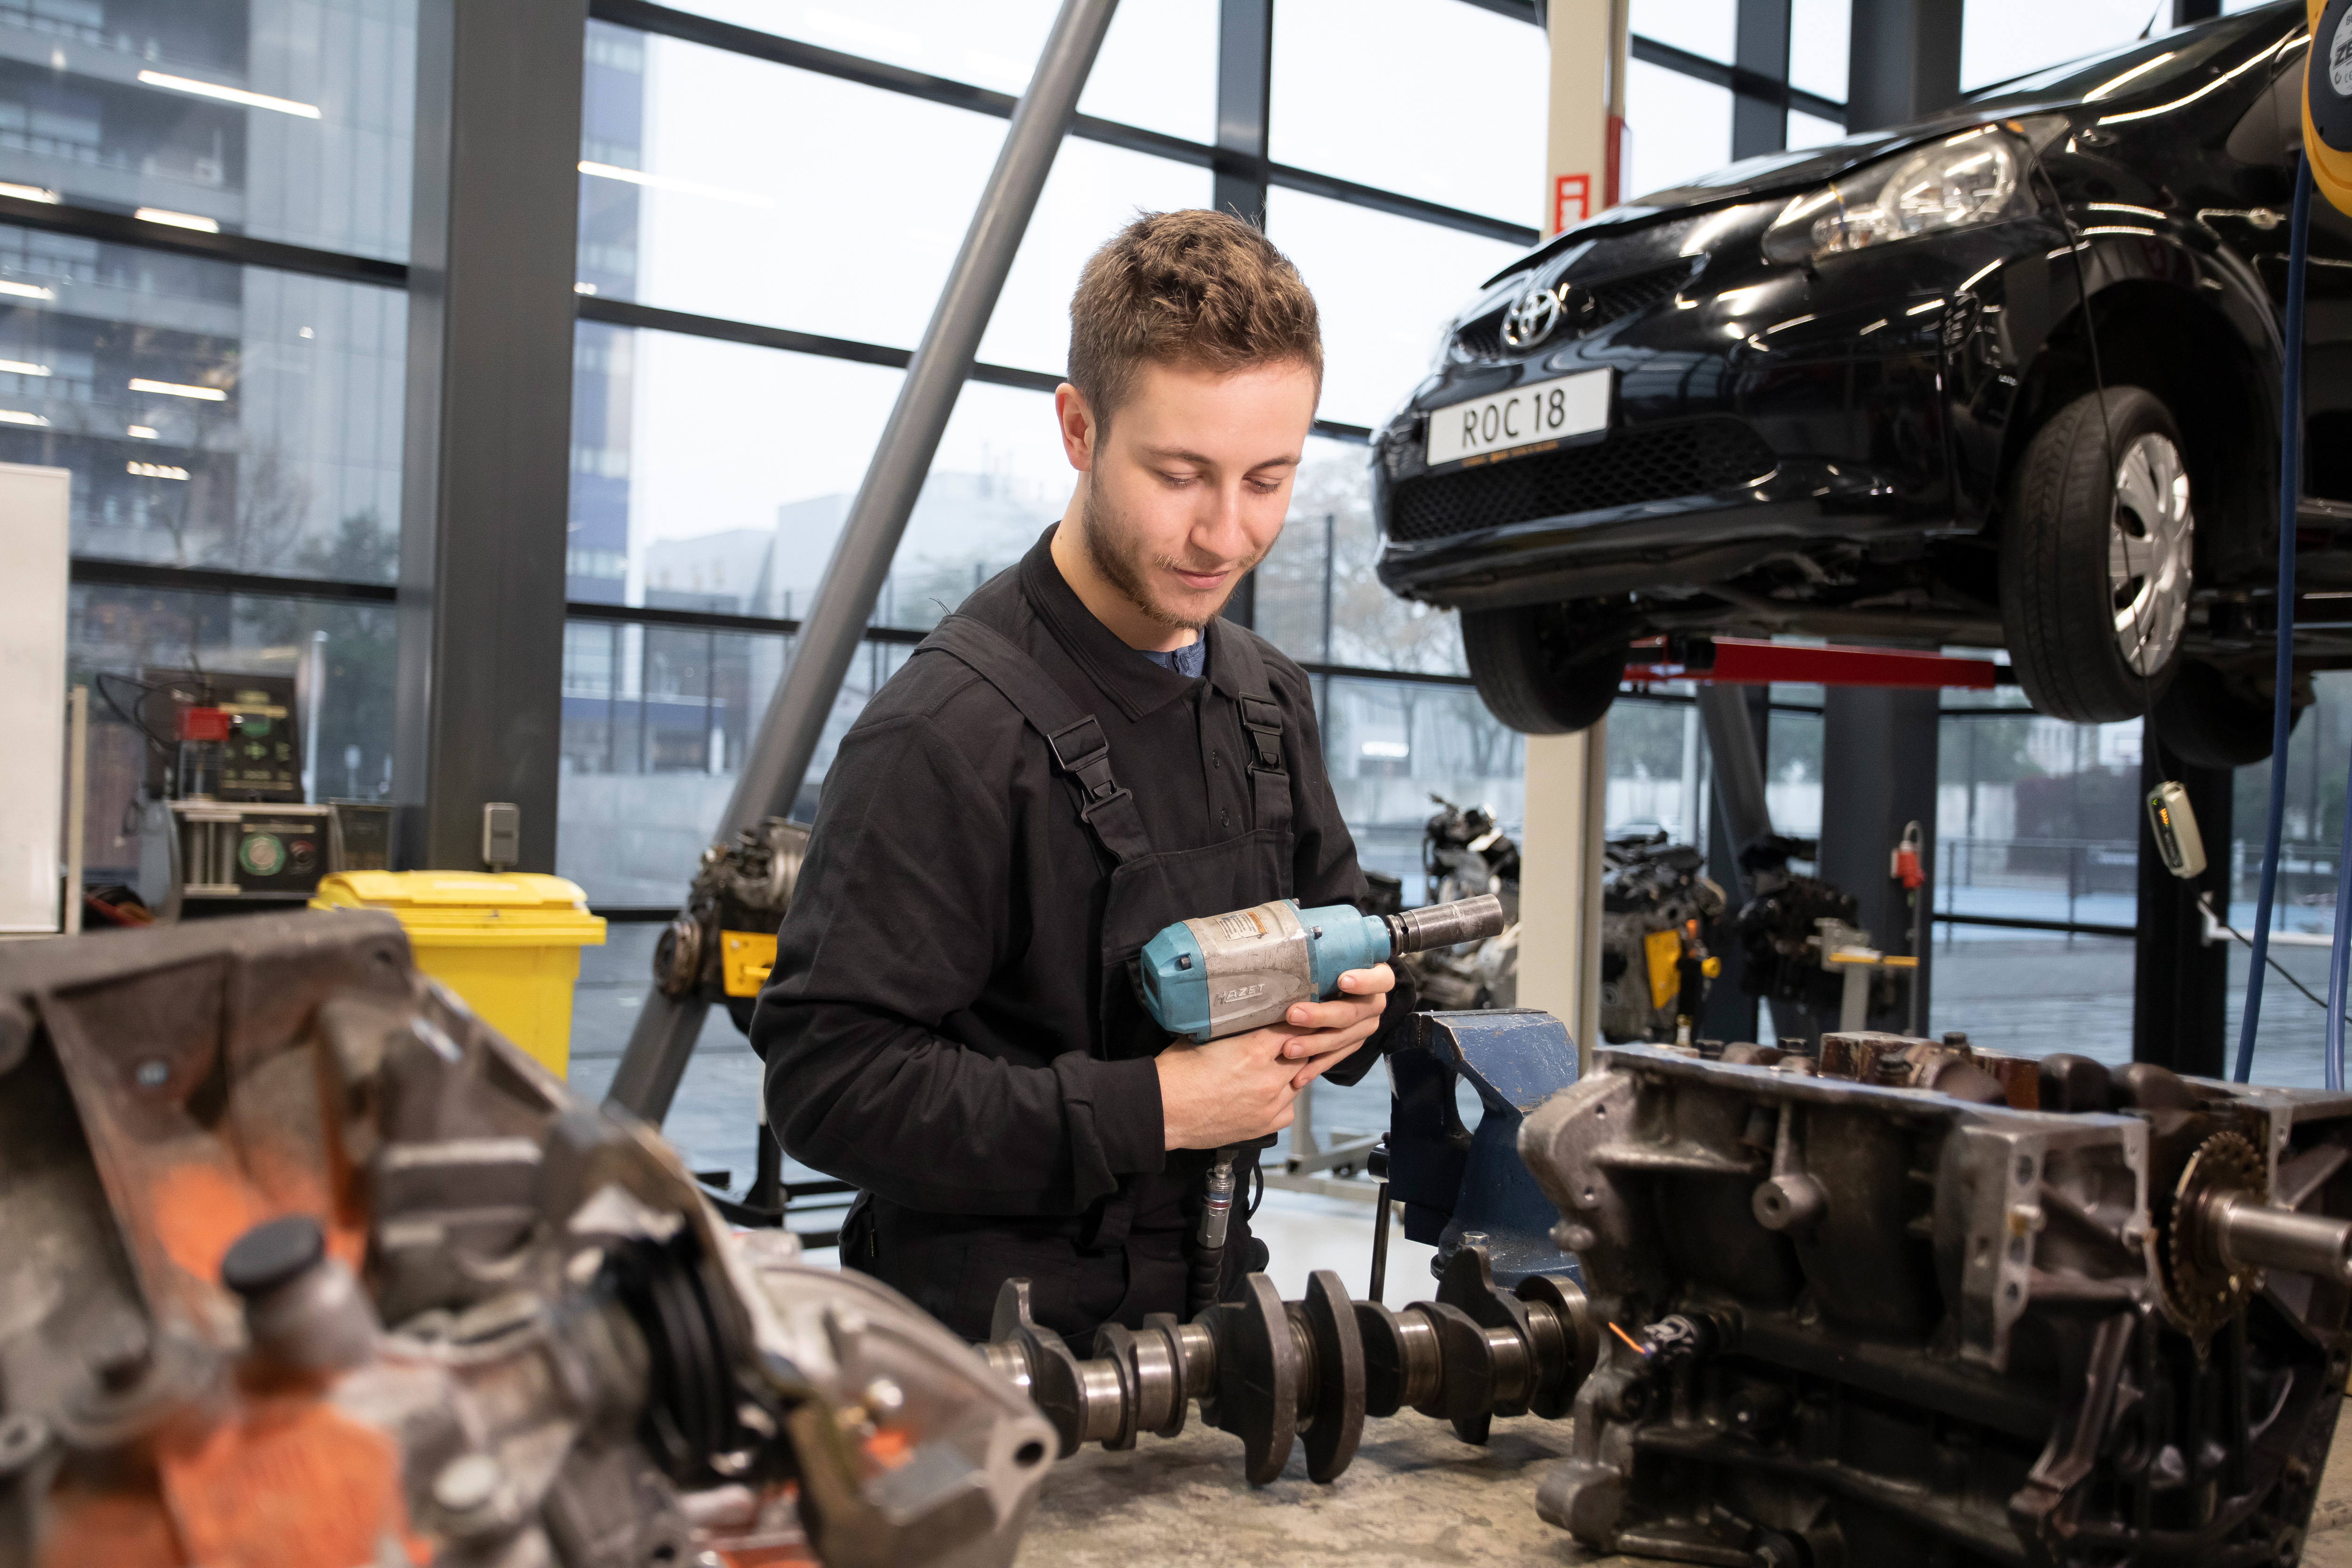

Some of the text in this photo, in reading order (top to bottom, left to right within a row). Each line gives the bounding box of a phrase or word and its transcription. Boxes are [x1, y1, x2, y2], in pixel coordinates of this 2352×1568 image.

[1462, 389, 1565, 448] ROC 18
[1214, 983, 1265, 1006] HAZET
